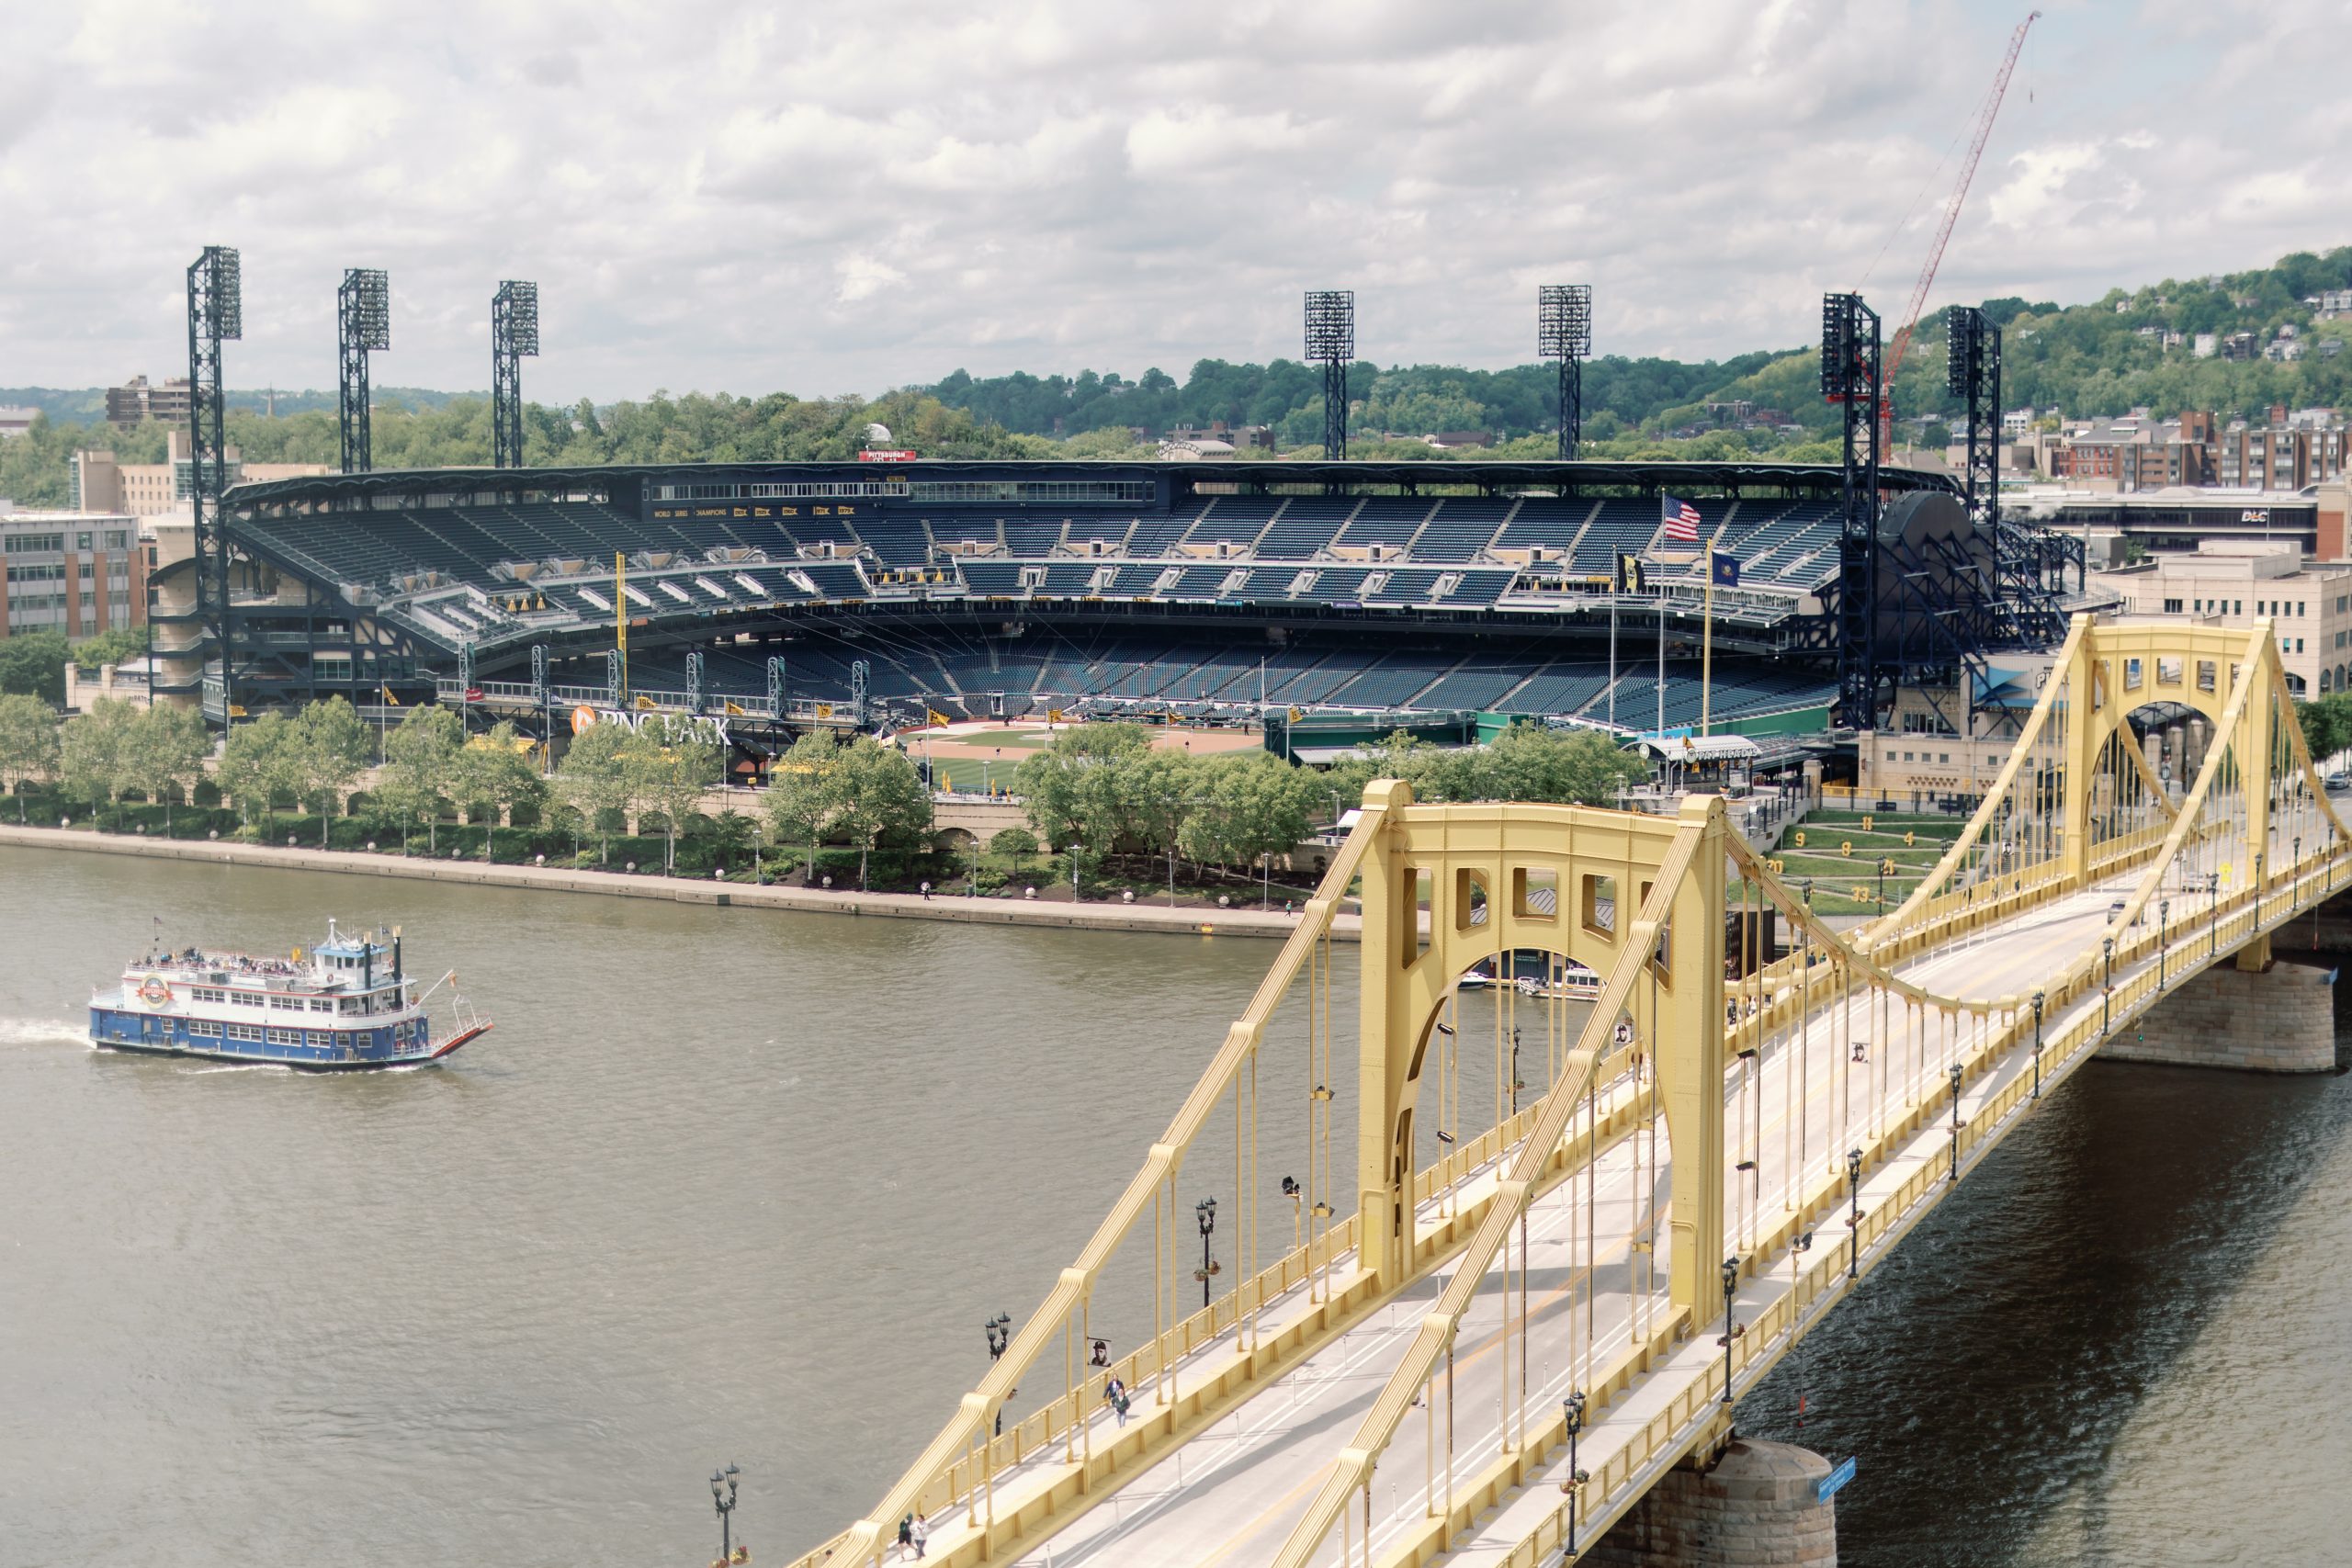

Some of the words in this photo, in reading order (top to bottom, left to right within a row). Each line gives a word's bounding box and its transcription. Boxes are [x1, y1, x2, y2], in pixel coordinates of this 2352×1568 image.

[695, 508, 727, 516] CHAMPIONS
[1861, 816, 1873, 830] 11
[1795, 832, 1806, 847] 9
[1904, 831, 1915, 846] 4
[1841, 841, 1852, 856] 8
[1851, 886, 1871, 903] 33
